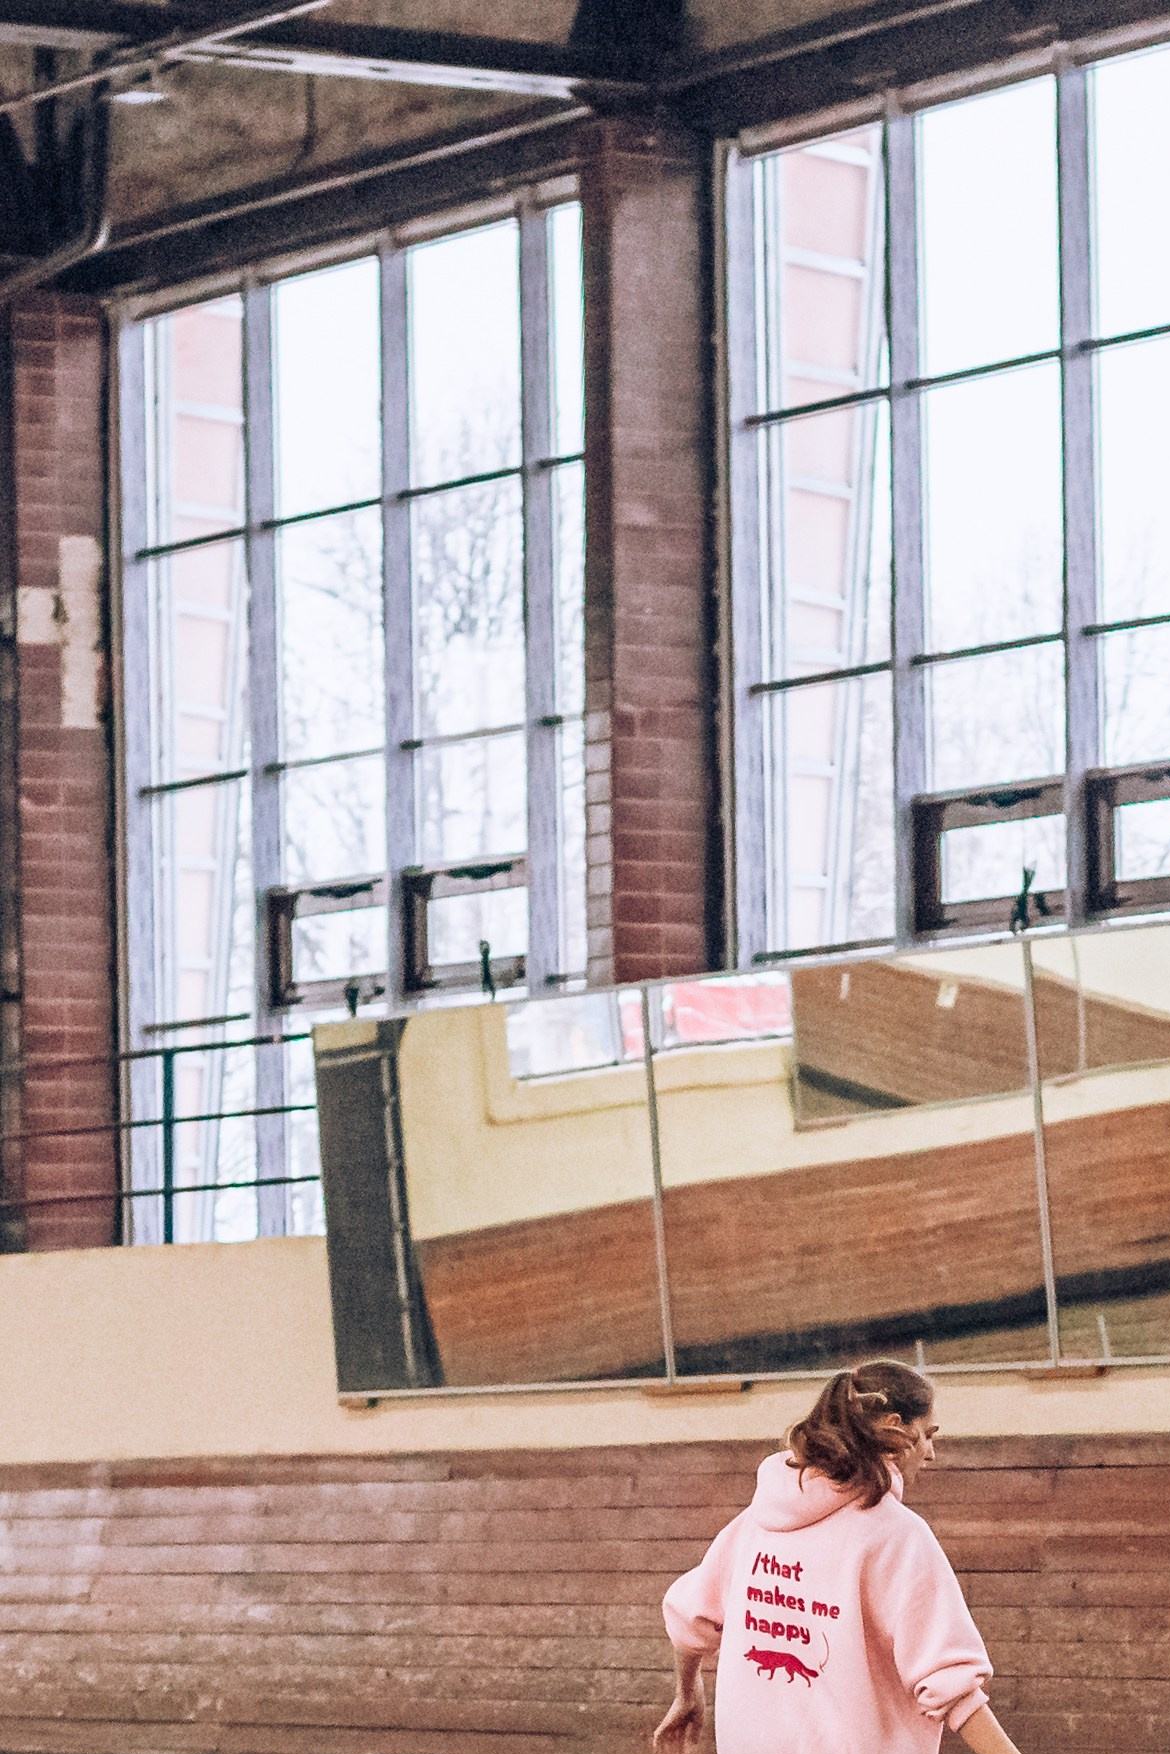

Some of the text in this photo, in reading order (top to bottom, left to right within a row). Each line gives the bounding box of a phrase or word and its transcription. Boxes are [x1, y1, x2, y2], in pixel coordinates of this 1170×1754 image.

[752, 1552, 803, 1582] /that
[747, 1586, 840, 1619] makes me
[745, 1610, 810, 1645] happy
